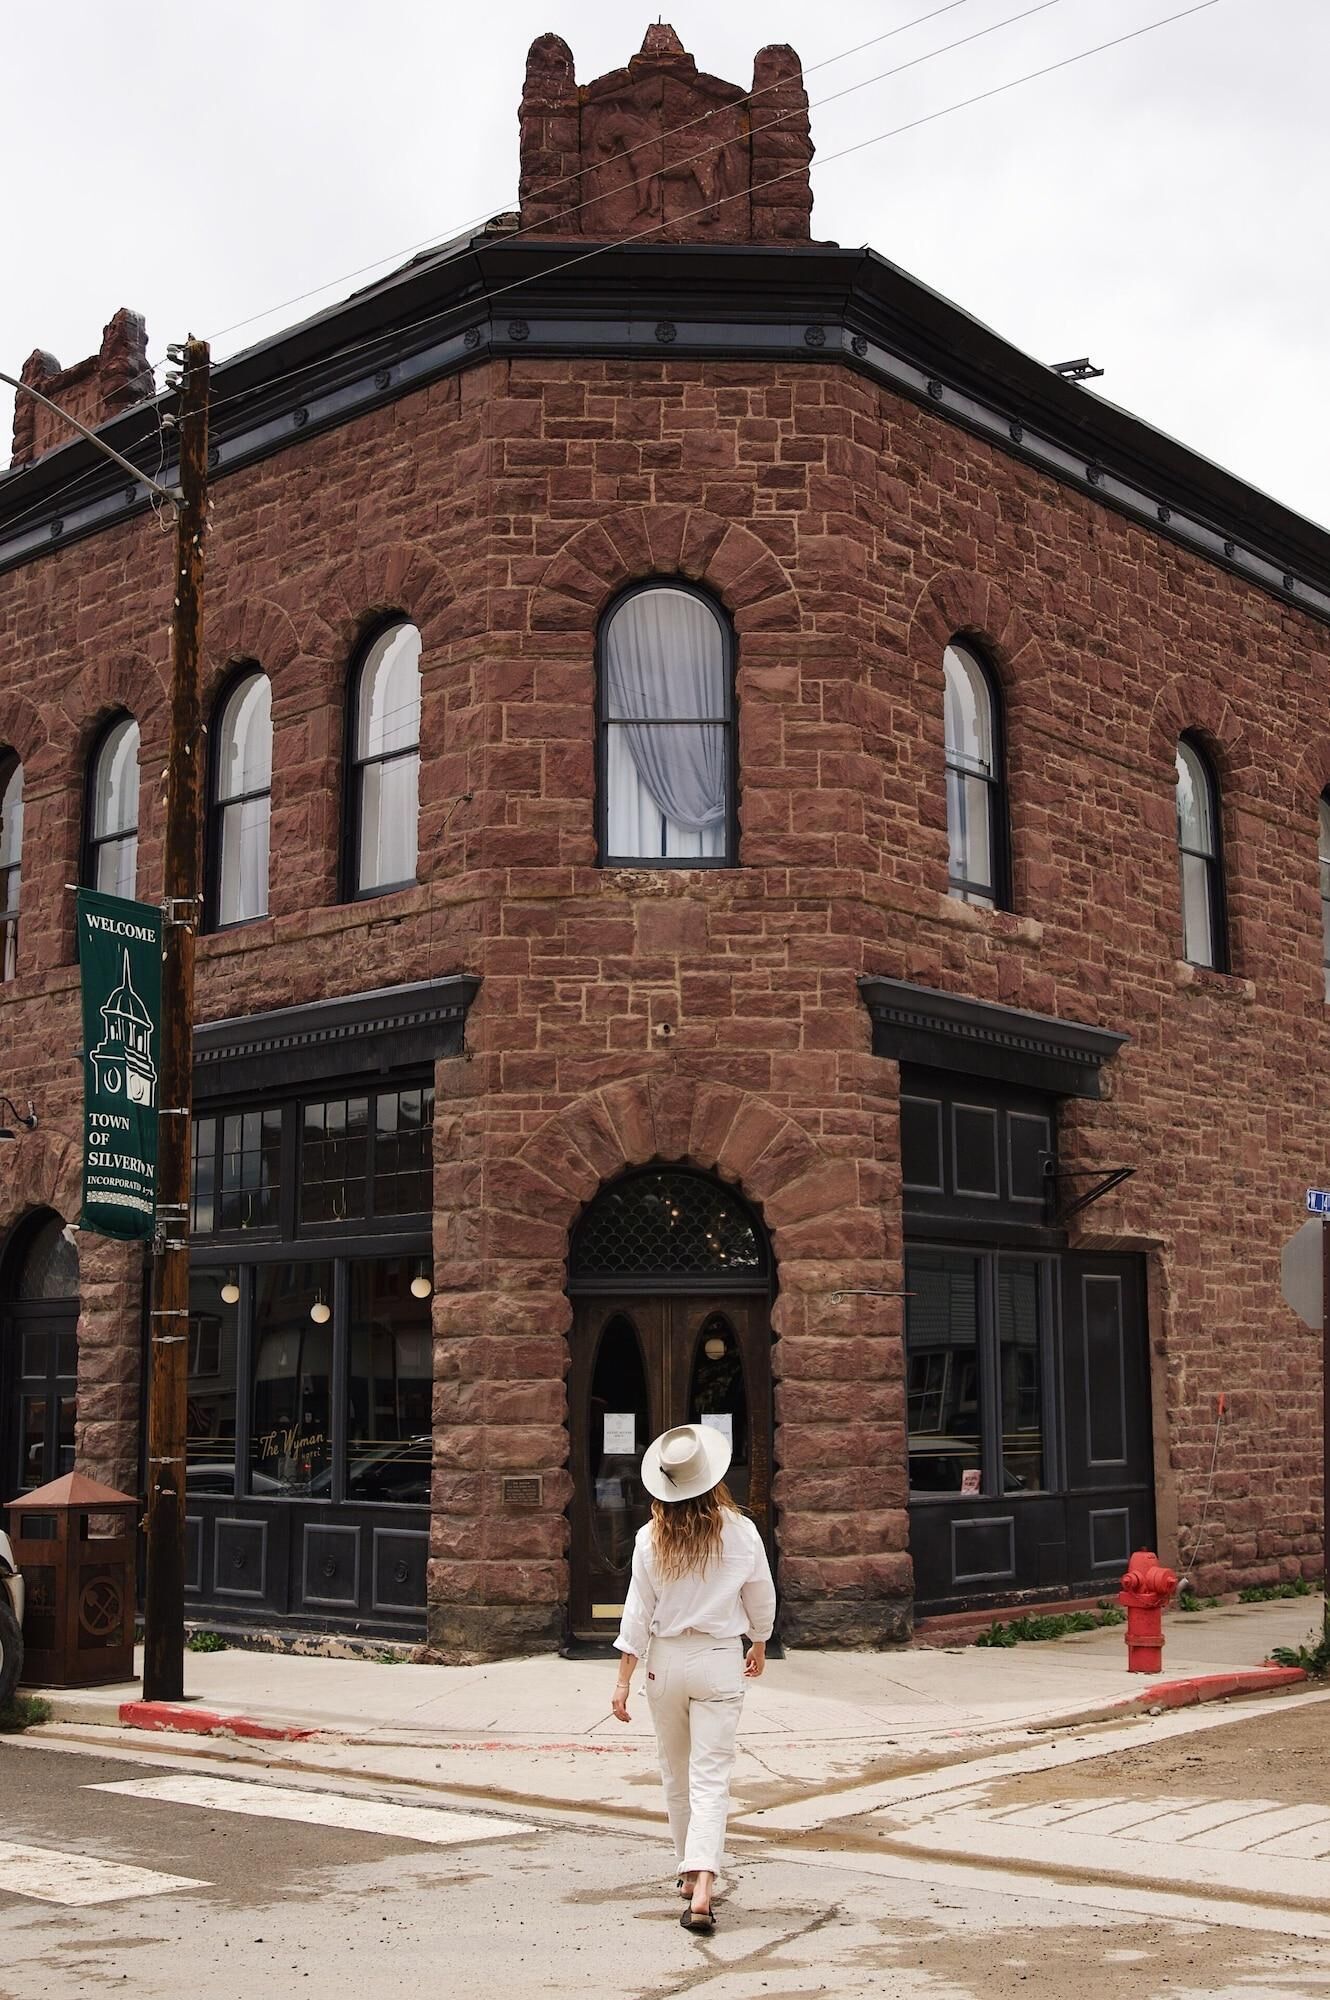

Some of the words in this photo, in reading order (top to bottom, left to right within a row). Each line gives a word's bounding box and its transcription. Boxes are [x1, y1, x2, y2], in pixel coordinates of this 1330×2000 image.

[85, 913, 156, 943] WELCOME
[89, 1113, 130, 1131] TOWN
[88, 1132, 110, 1146] OF
[87, 1176, 142, 1191] INCORPORATD
[260, 1430, 279, 1460] The
[281, 1423, 324, 1461] Wyman
